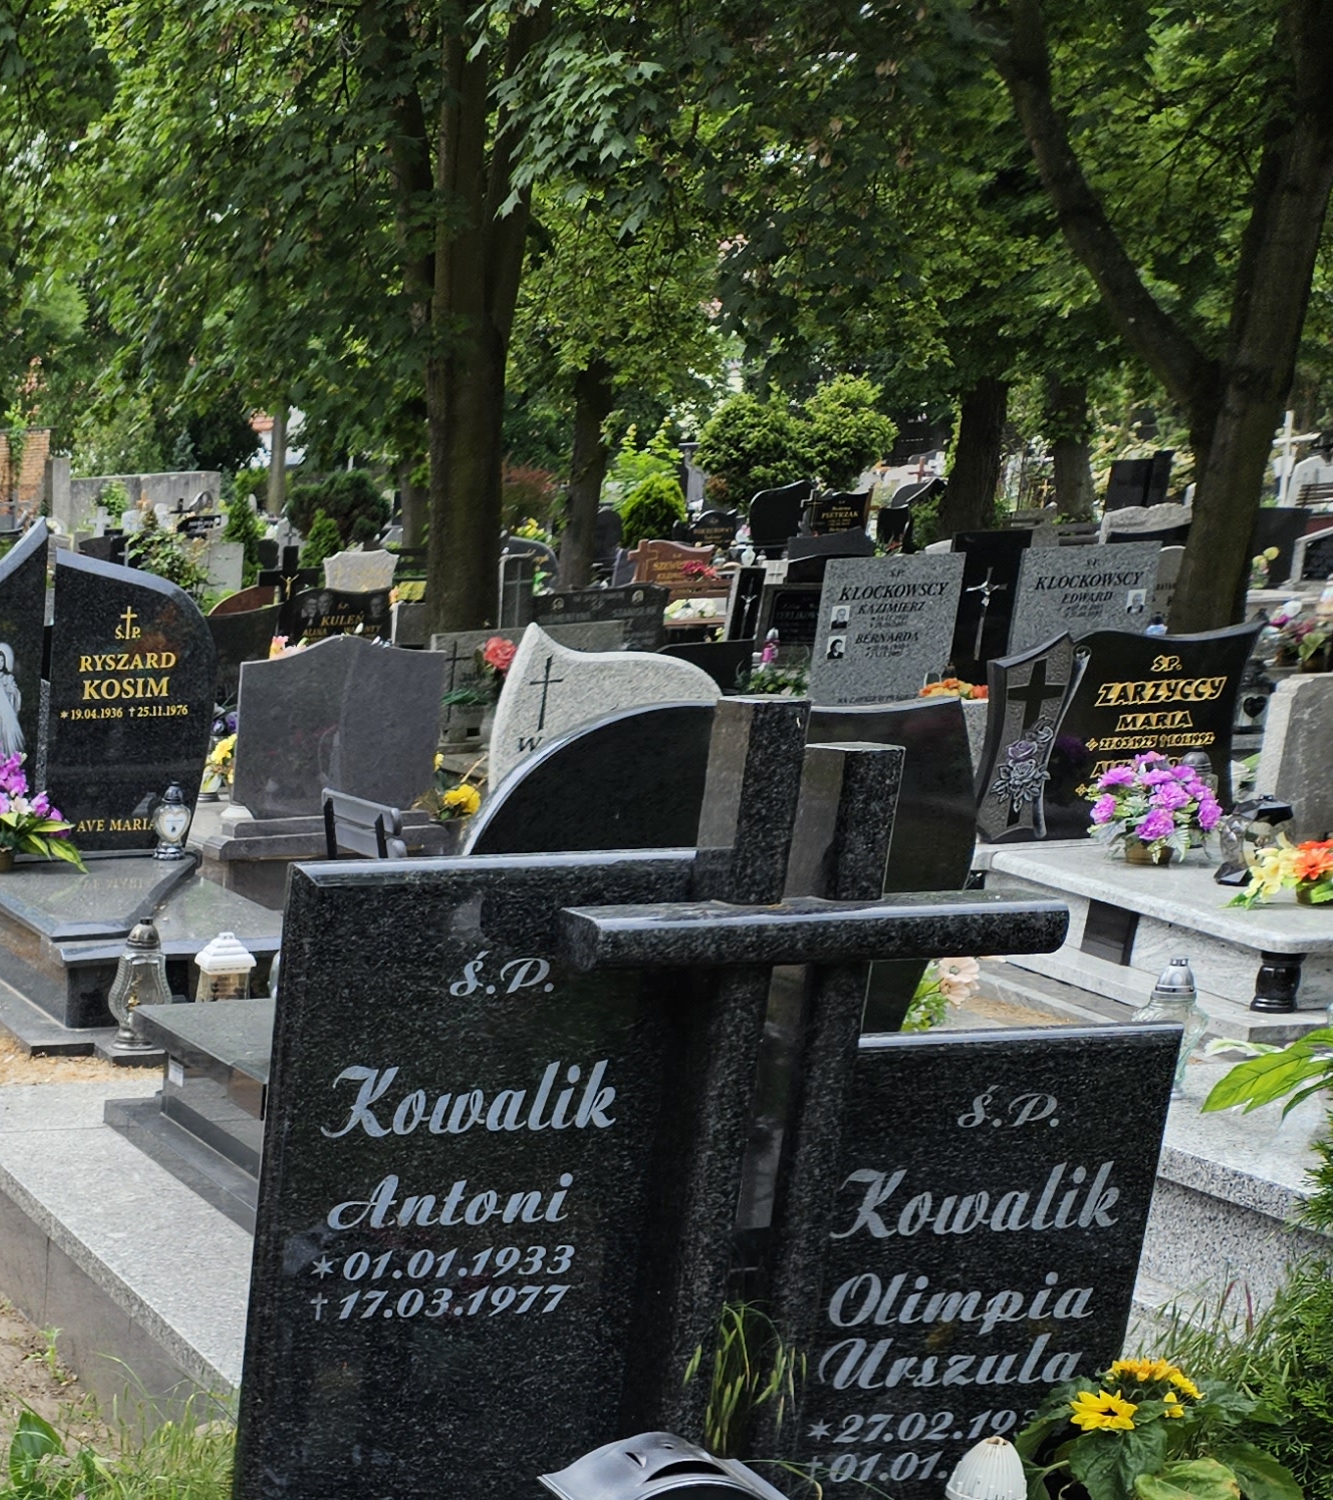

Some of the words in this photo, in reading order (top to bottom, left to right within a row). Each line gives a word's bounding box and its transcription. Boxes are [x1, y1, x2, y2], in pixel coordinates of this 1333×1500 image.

[857, 602, 926, 615] KAZIMIERZ
[1061, 591, 1113, 604] EDWARD
[321, 610, 365, 626] KULEŃ
[855, 632, 919, 644] BERNARDA
[79, 652, 176, 672] RYSZARD
[83, 677, 169, 699] KOSIM
[1094, 676, 1227, 707] ZARZYCCY
[71, 707, 123, 720] 19.04.1936
[137, 705, 188, 718] 25.11.1976
[1115, 711, 1193, 732] MARIA
[77, 819, 104, 832] AVE
[110, 818, 155, 831] MARIA
[449, 951, 555, 997] Ś.P.
[320, 1060, 616, 1138] Kowalik
[958, 1085, 1060, 1128] Ś.P.
[327, 1172, 573, 1230] Antoni
[829, 1160, 1119, 1239] Kowalik
[342, 1245, 574, 1281] 01.01.1933
[339, 1285, 571, 1320] 17.03.1977
[828, 1271, 1094, 1335] Olimpia
[819, 1332, 1083, 1391] Urszula
[833, 1410, 1039, 1443] 27.02.19
[829, 1451, 948, 1482] 01.01.
